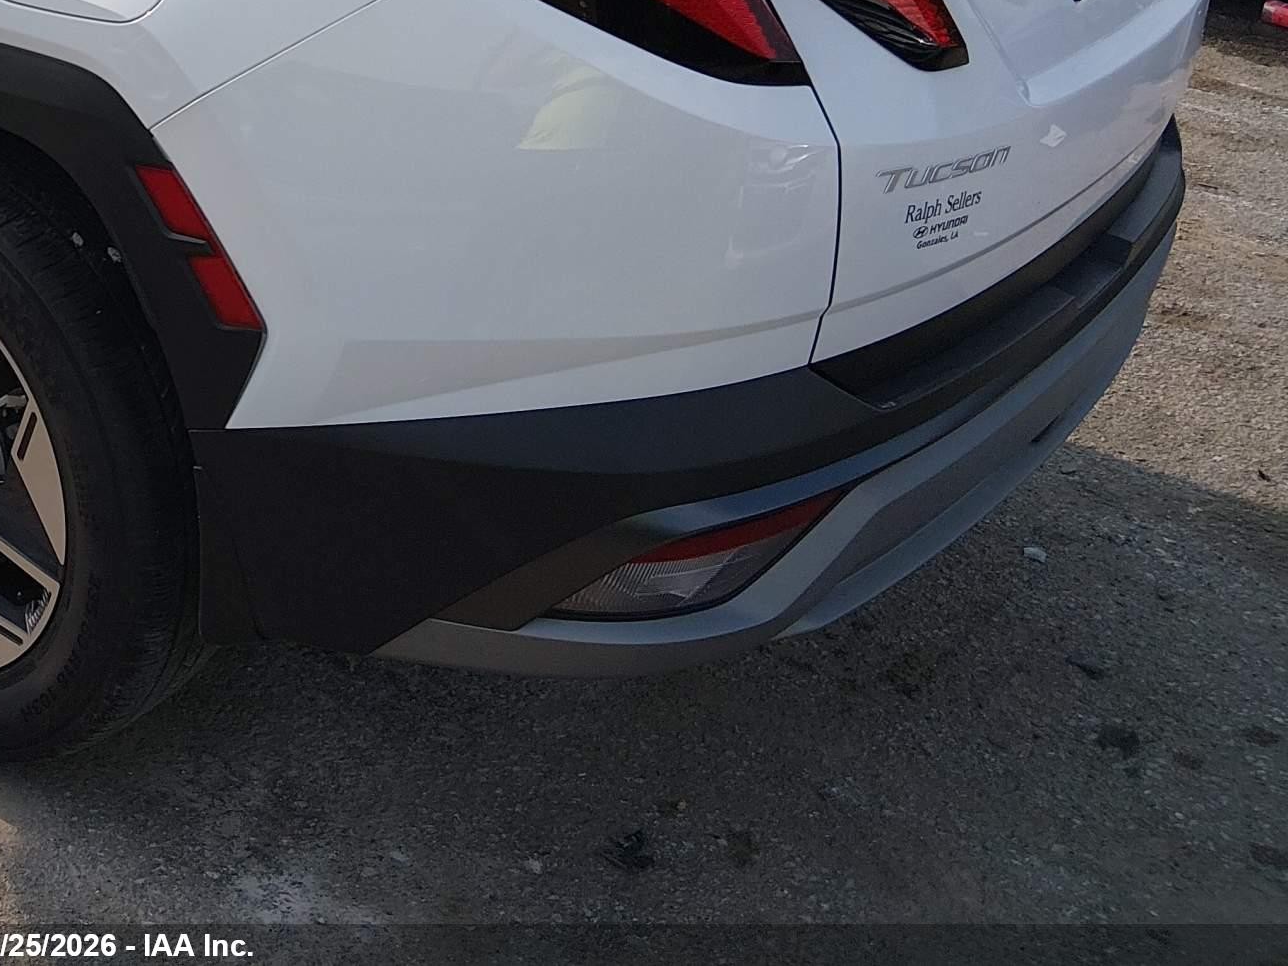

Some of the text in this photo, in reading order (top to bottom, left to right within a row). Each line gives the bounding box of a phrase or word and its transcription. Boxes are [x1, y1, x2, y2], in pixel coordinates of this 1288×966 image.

[875, 146, 1011, 194] TUCSON
[904, 191, 982, 224] Ralph Sellers
[929, 215, 968, 234] HYUNDAI
